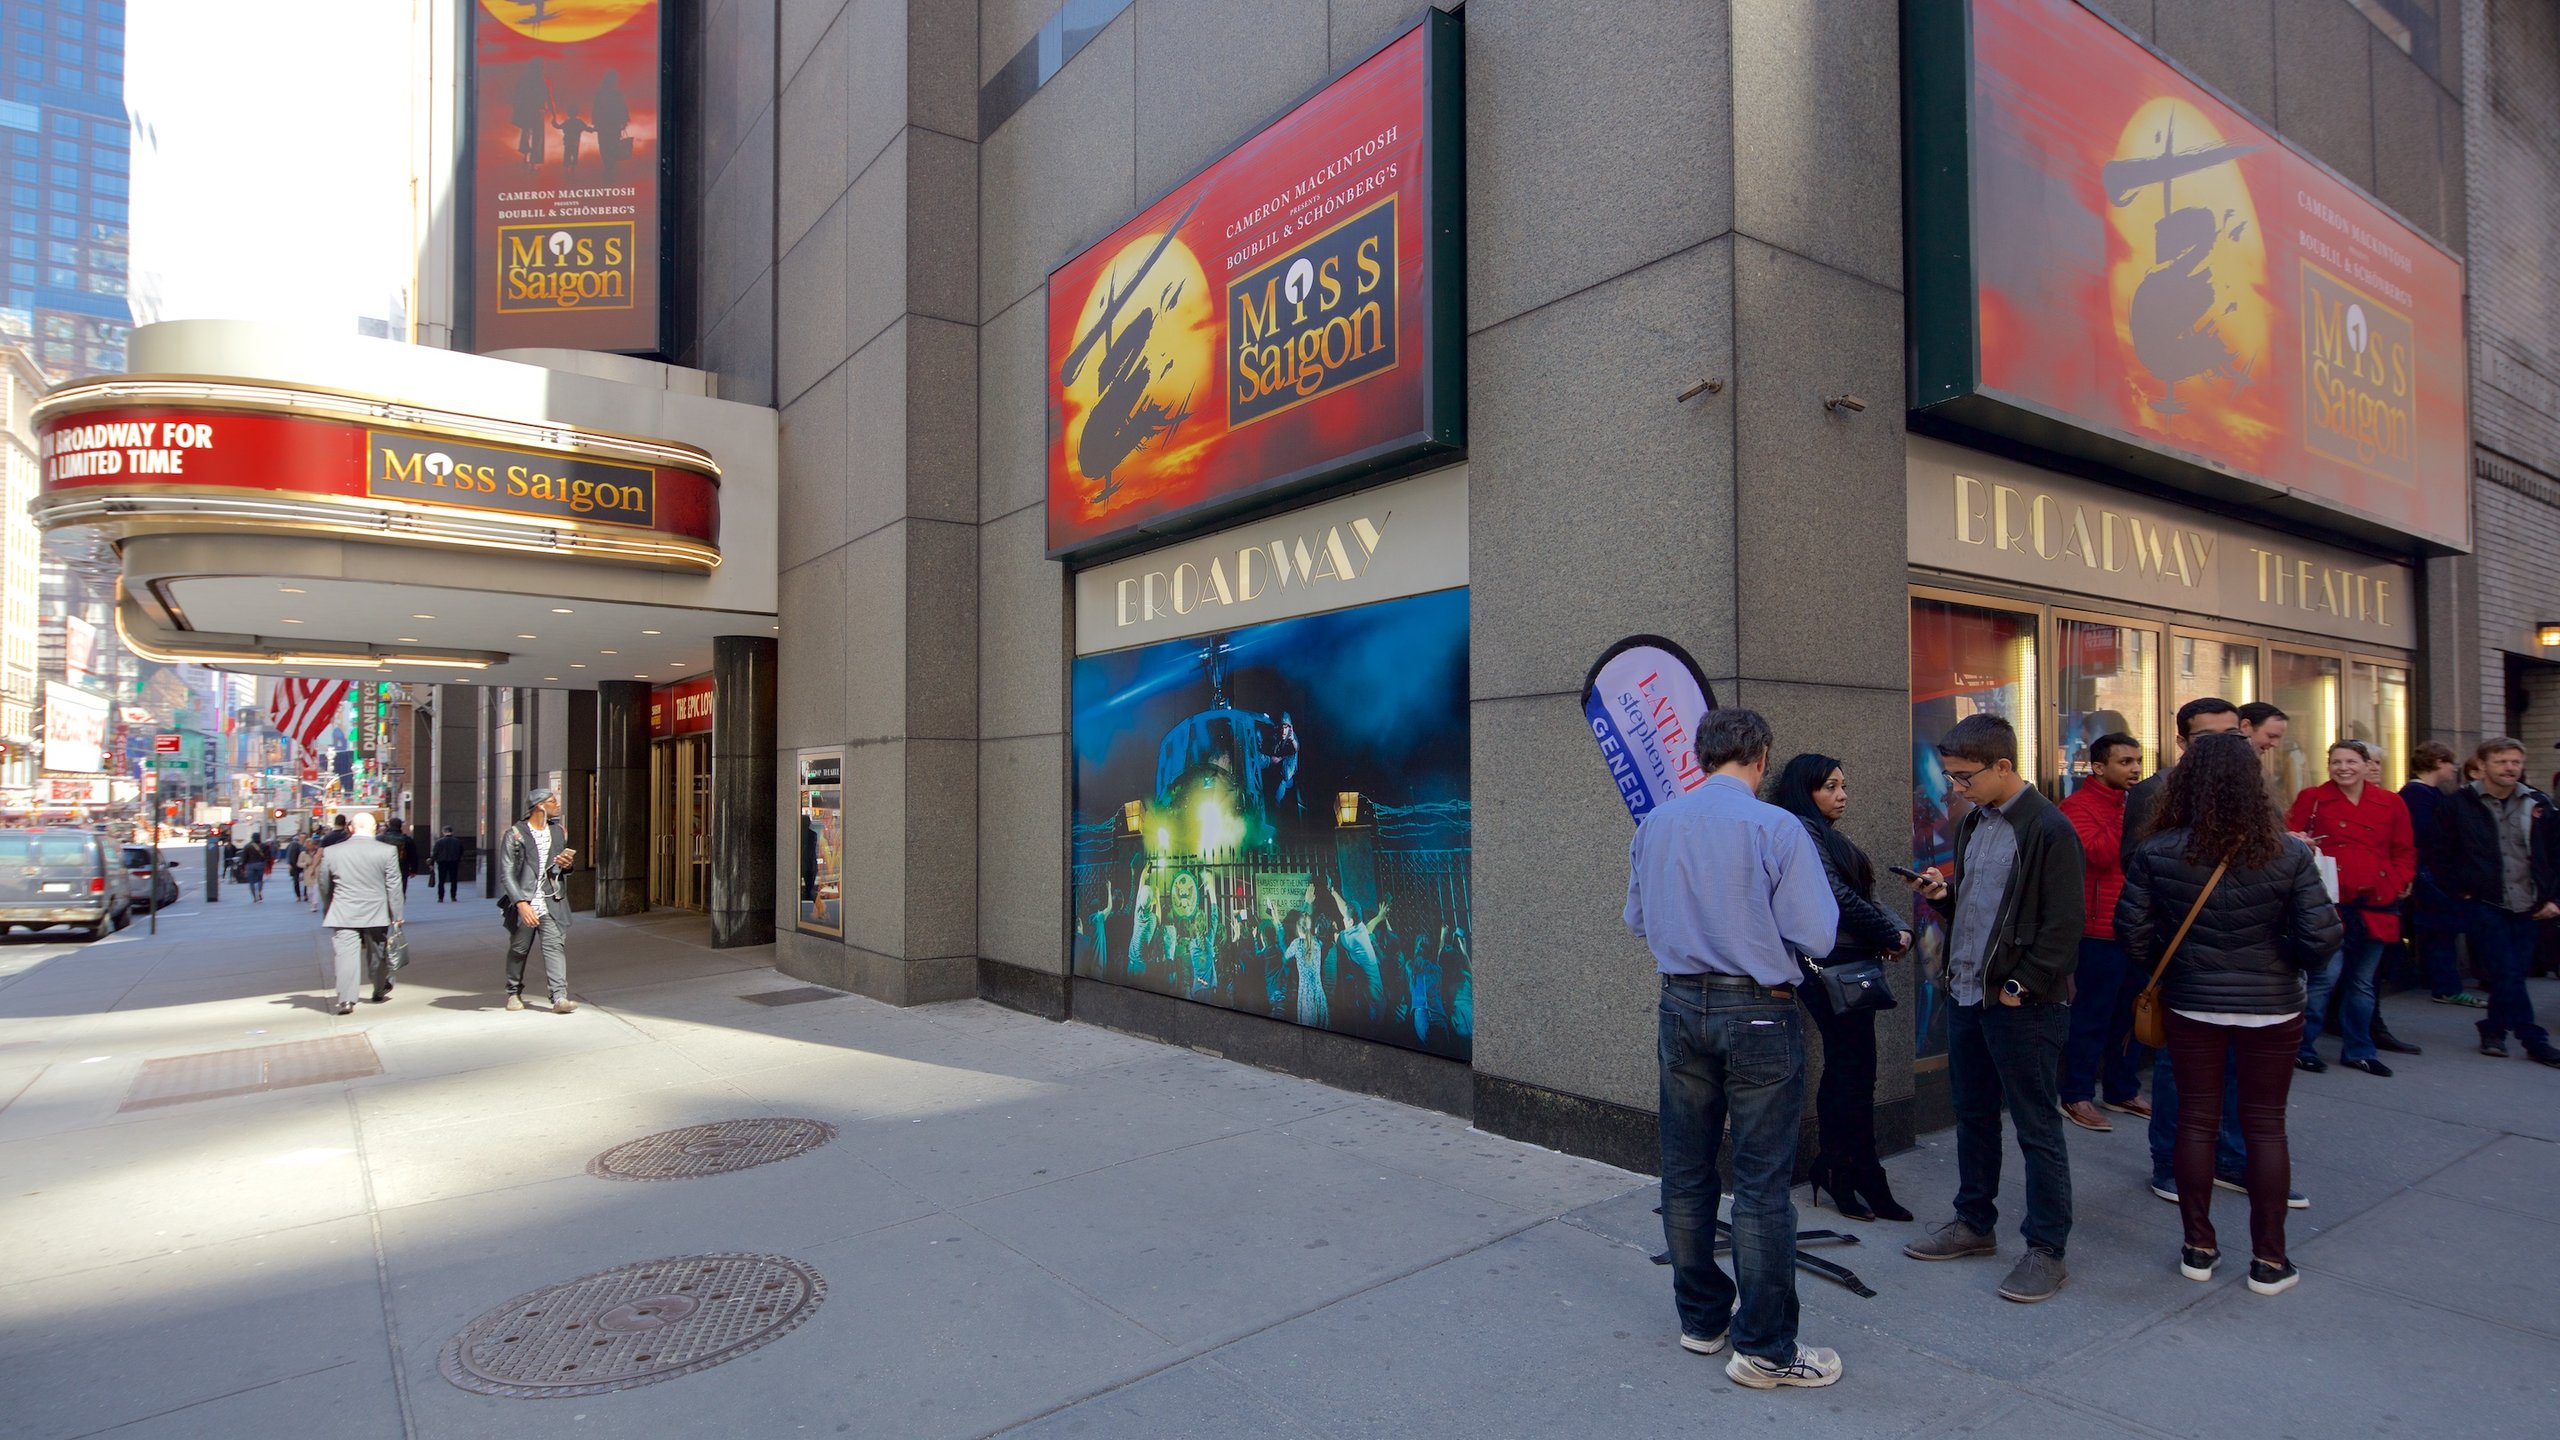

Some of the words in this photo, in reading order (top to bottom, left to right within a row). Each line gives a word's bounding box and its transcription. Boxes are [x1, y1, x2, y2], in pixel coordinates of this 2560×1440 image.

[498, 190, 555, 201] CAMERON
[558, 187, 635, 199] MACKINTOSH
[1226, 190, 1291, 239] CAMERON
[1294, 125, 1398, 199] MACKINTOSH
[1290, 194, 1321, 216] PRESENTS
[498, 209, 545, 219] BOUBLIL
[548, 208, 557, 217] &
[1227, 231, 1279, 270] BOUBLIL
[1283, 223, 1293, 238] &
[1297, 162, 1398, 231] SCHÖNBERG'S
[2298, 190, 2349, 234] CAMERON
[2299, 230, 2343, 268] BOUBLIL
[508, 266, 624, 307] Saigon
[1239, 301, 1386, 405] Saigon
[2312, 358, 2410, 465] Saigon
[56, 422, 157, 455] BROADWAY
[162, 422, 213, 449] FOR
[49, 458, 58, 482] A
[59, 450, 123, 480] LIMITED
[127, 449, 183, 474] TIME
[506, 465, 647, 513] Saigon
[1115, 511, 1391, 627] BROADWAY
[1953, 473, 2215, 588] BROADWAY
[2249, 547, 2393, 627] THEATRE
[676, 697, 687, 721] THE
[687, 694, 700, 719] EPIC
[1637, 671, 1688, 754] LATE
[1617, 692, 1665, 780] stephen
